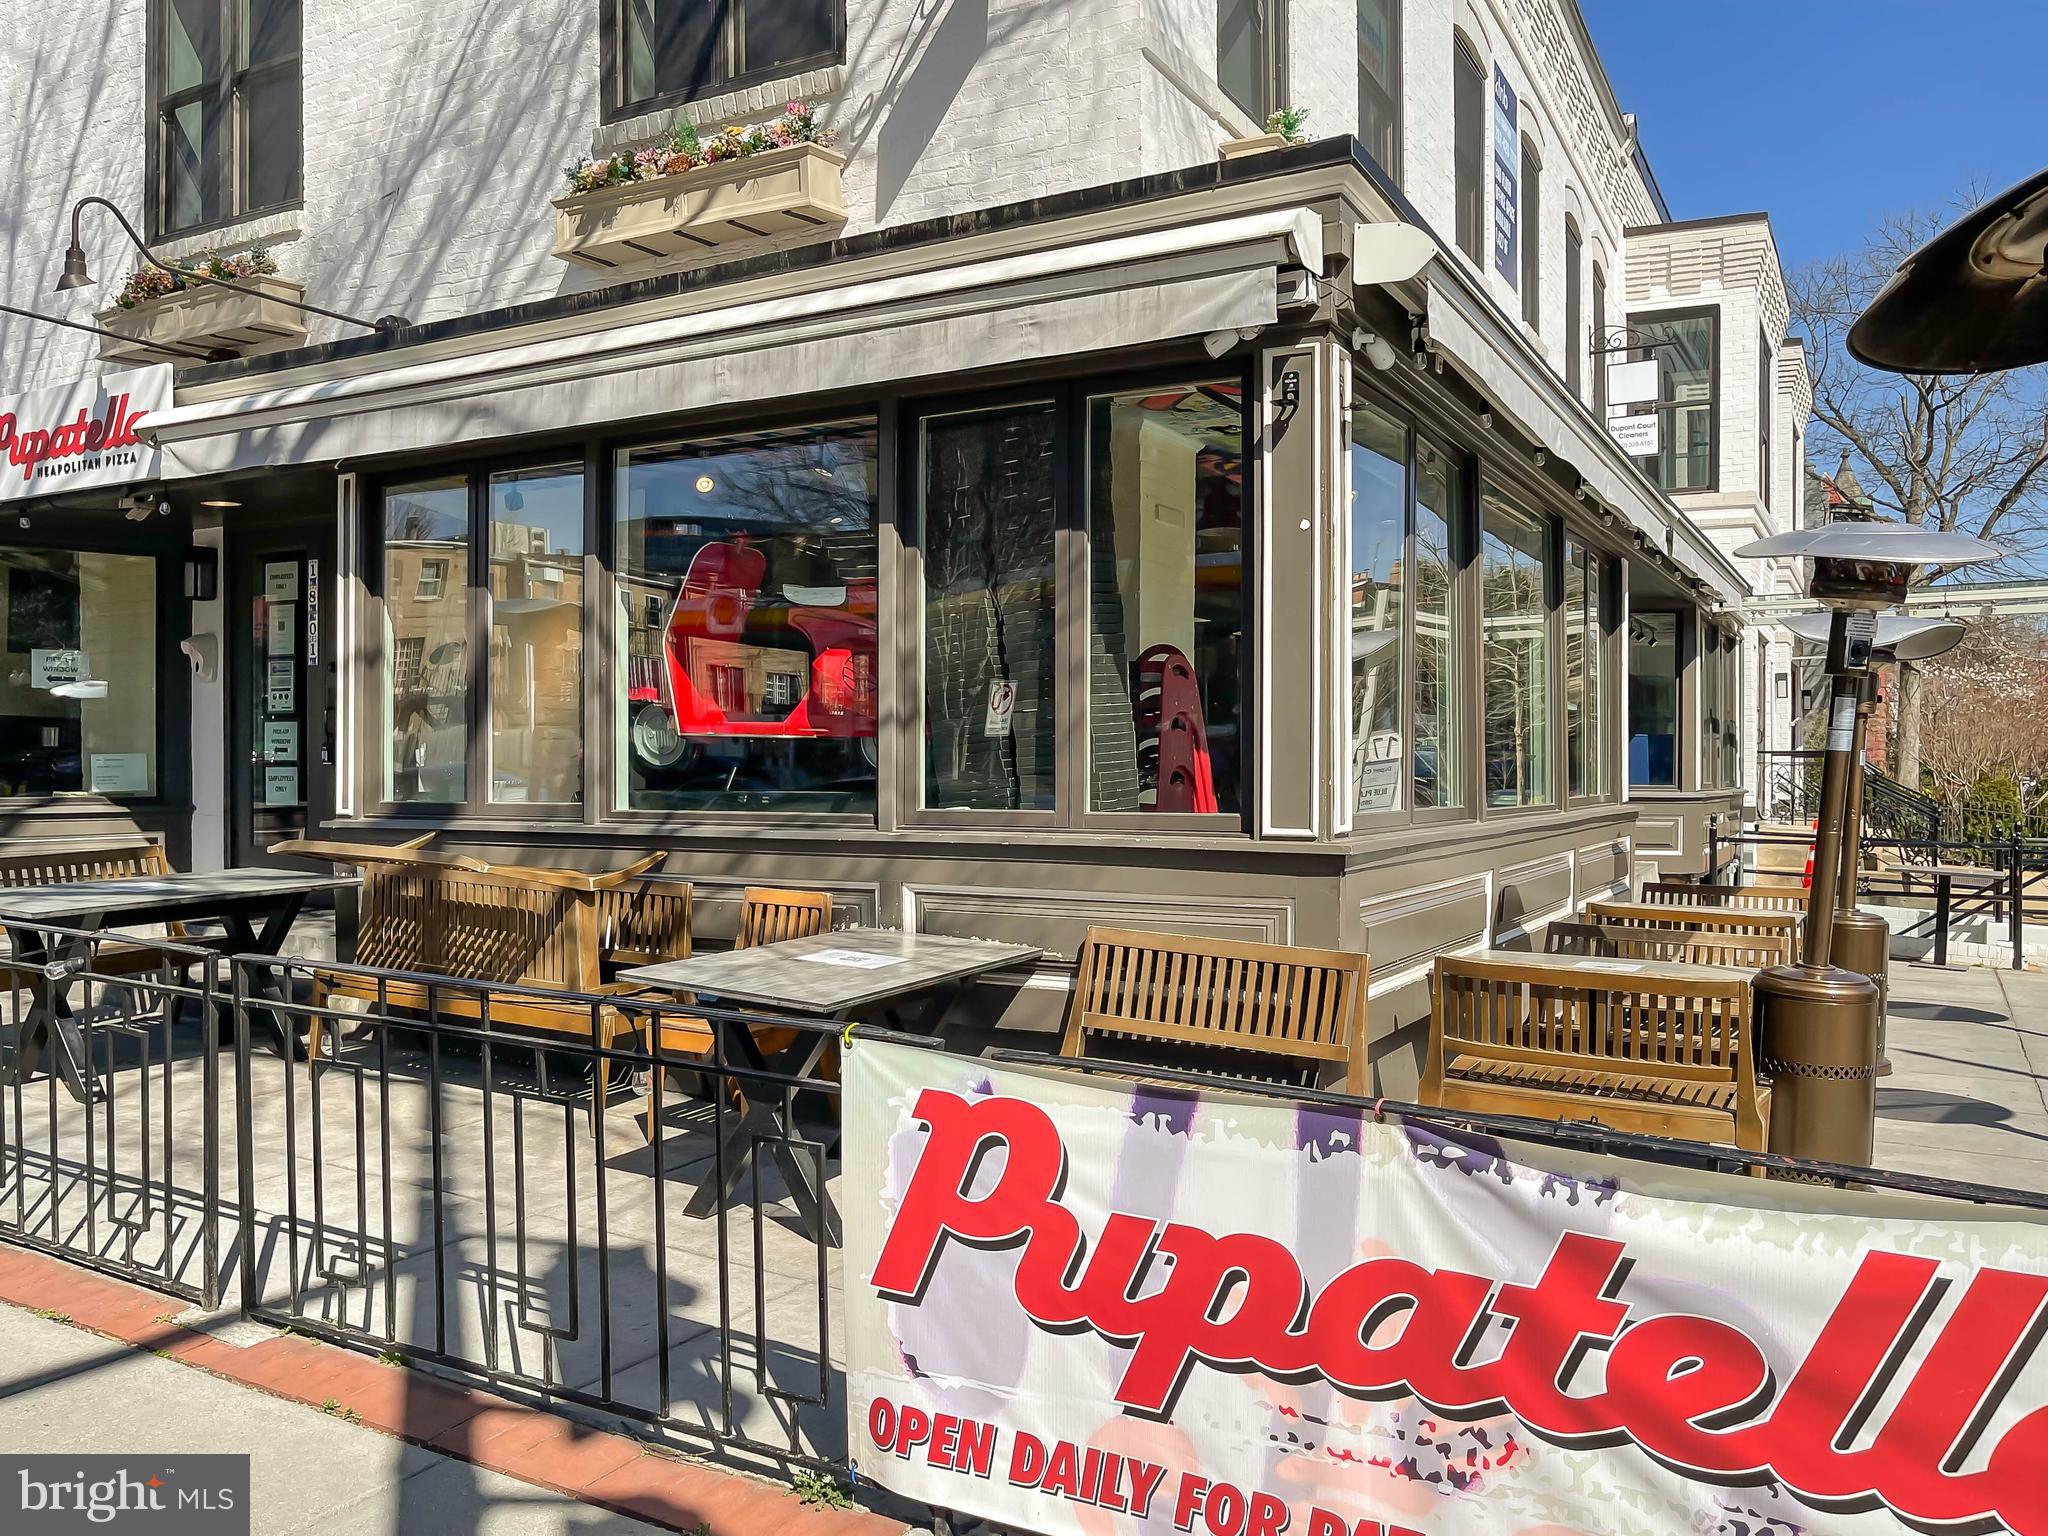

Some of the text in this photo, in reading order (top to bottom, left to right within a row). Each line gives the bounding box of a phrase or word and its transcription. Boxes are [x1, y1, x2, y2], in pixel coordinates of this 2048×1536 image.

[1610, 424, 1636, 432] Dupont
[37, 452, 137, 478] NEAPOLITAN PIZZA
[867, 1397, 1292, 1536] OPEN DAILY FOR
